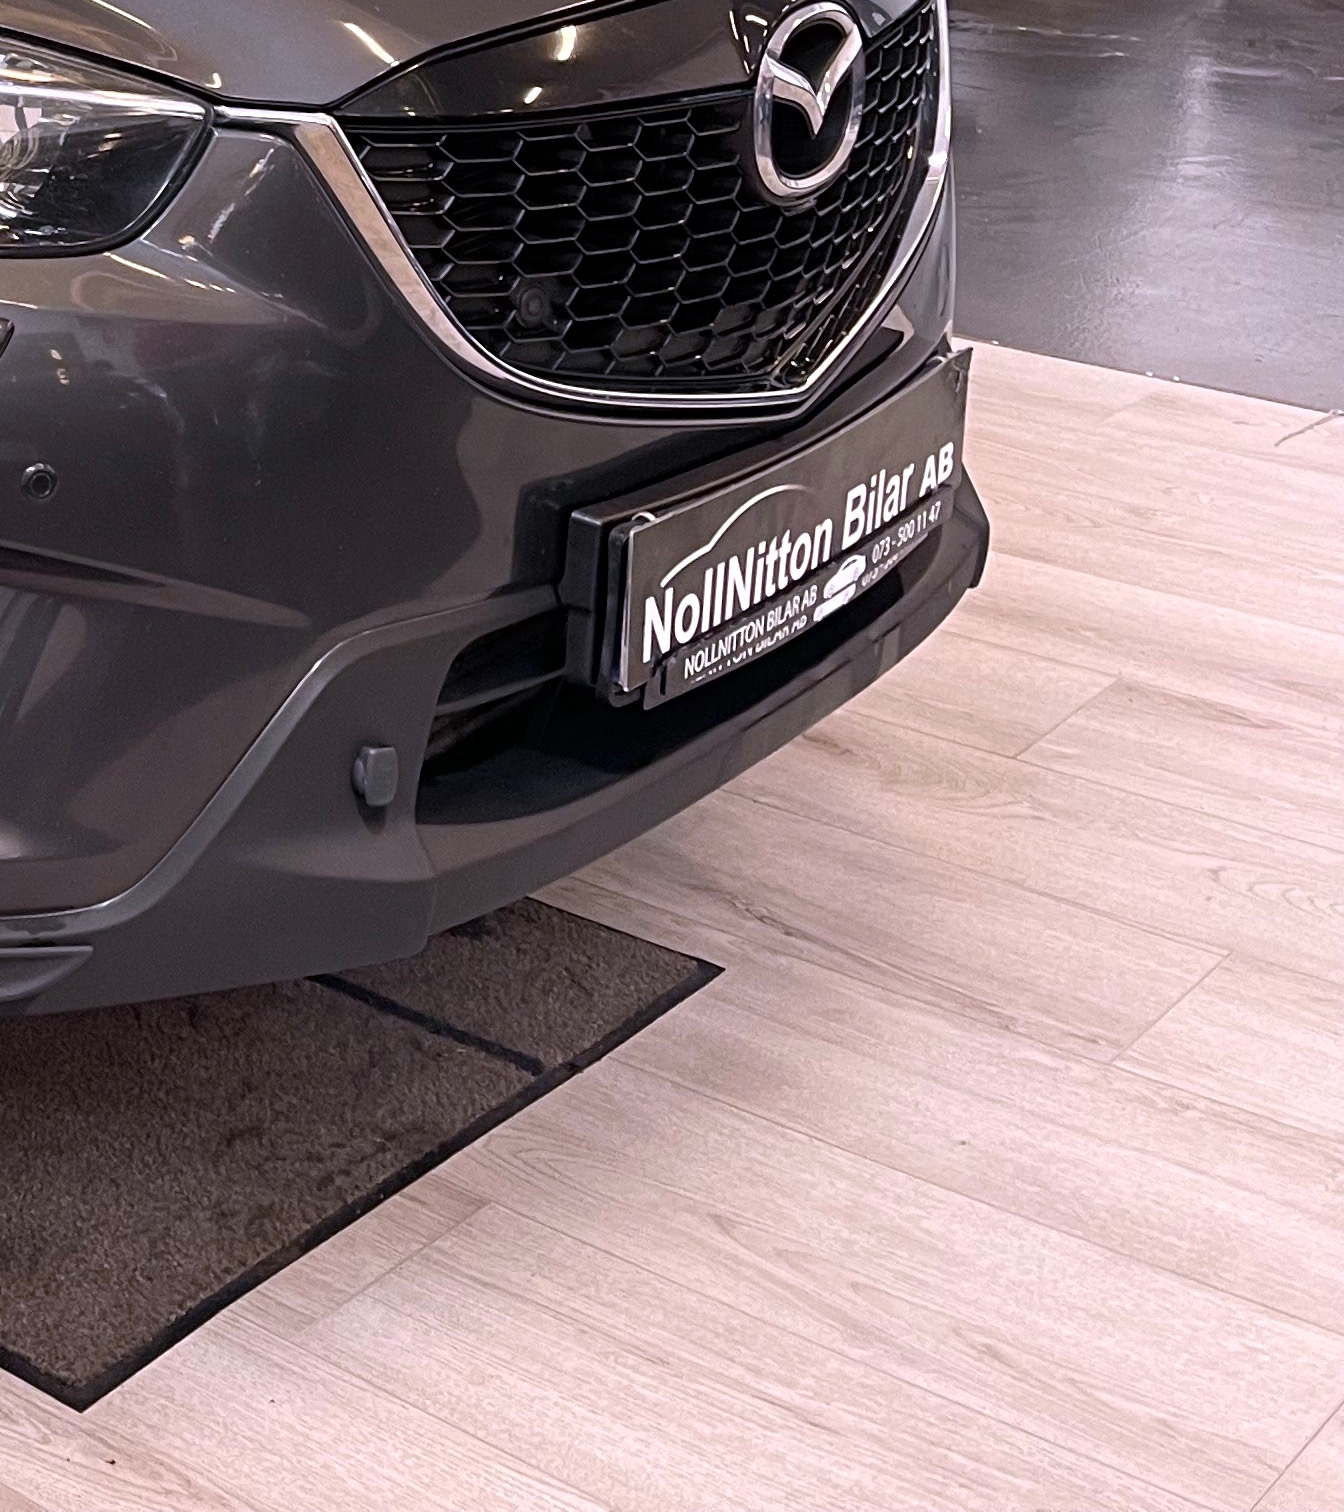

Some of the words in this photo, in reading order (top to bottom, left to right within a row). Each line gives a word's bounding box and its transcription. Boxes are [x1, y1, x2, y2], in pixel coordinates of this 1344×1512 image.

[642, 518, 833, 664] NollNitton
[841, 463, 915, 550] Bilar
[919, 442, 955, 497] AB
[872, 536, 891, 564] 073
[897, 519, 915, 547] 500
[916, 510, 927, 533] 11
[928, 500, 942, 523] 47
[684, 615, 765, 680] NOLLNITTON
[766, 595, 801, 632] BILAR
[801, 584, 818, 612] AB
